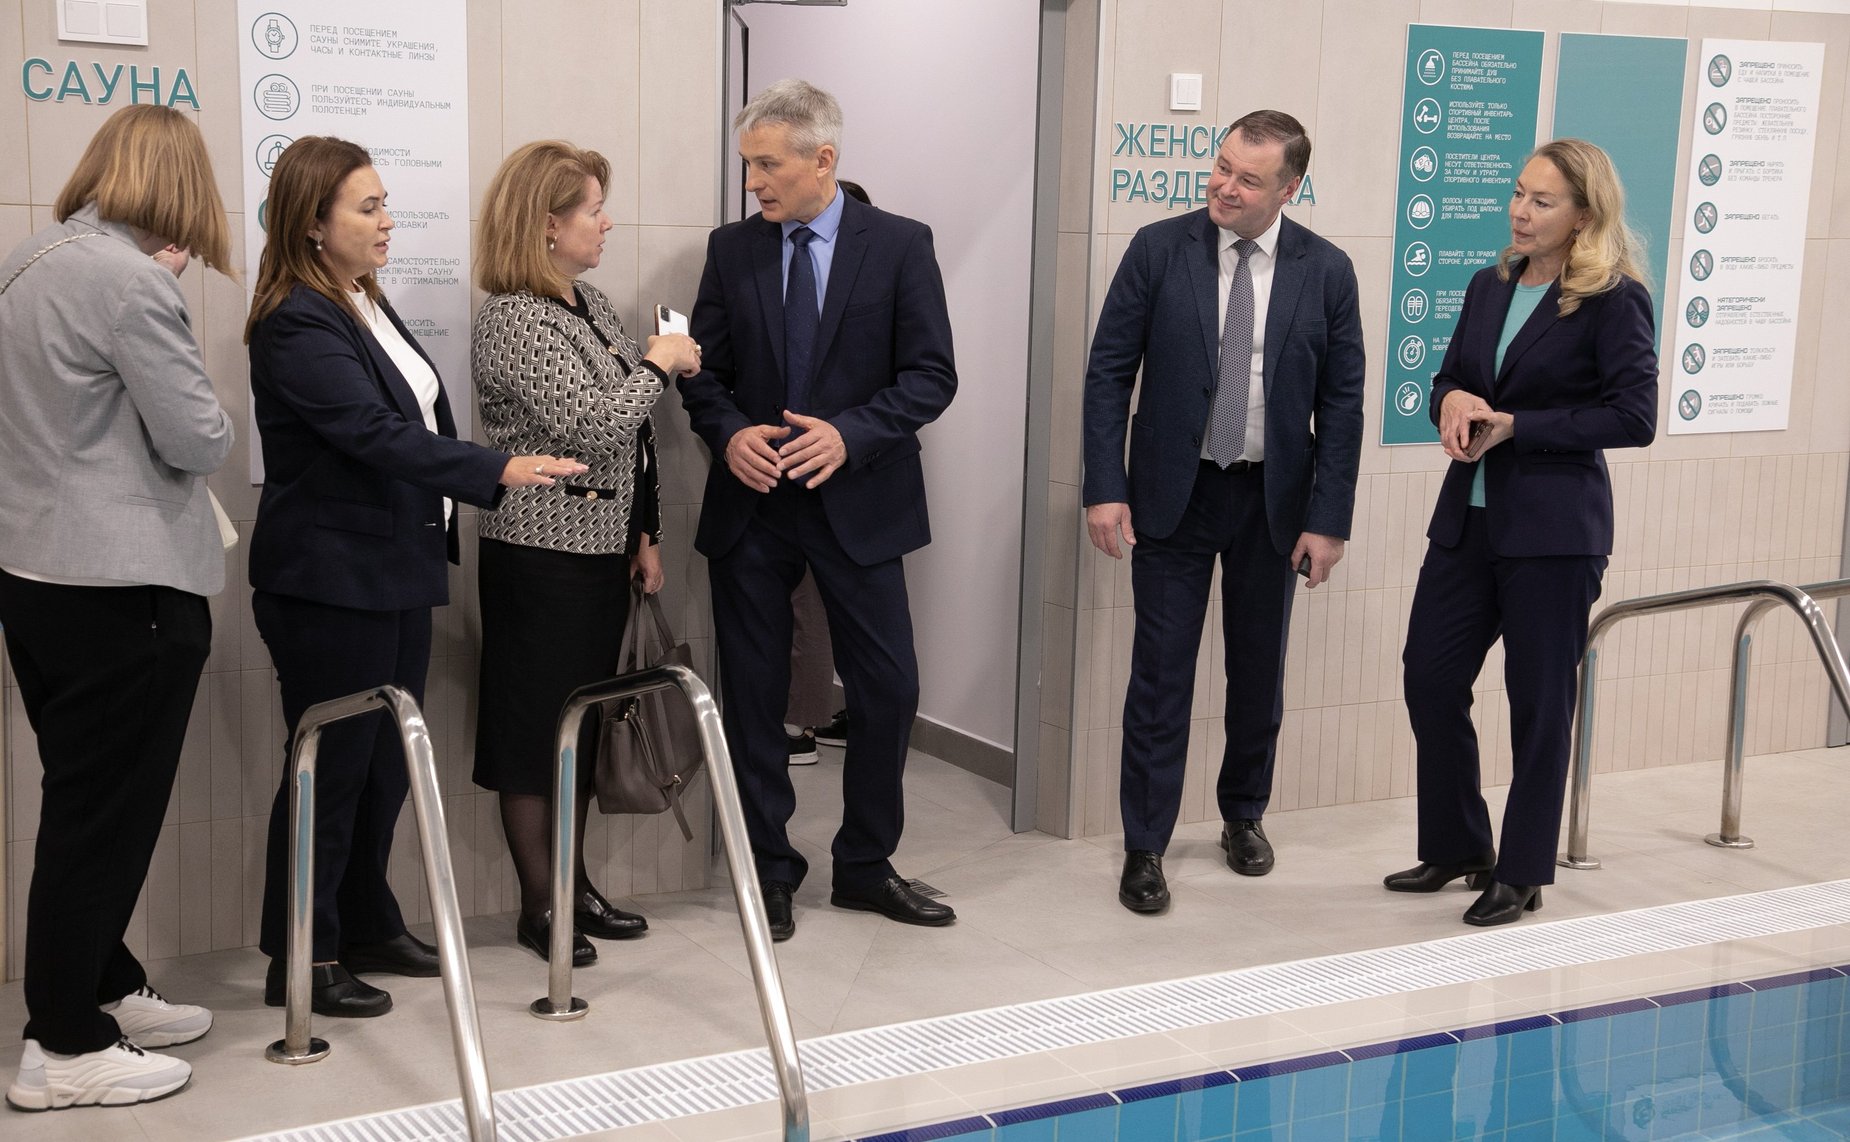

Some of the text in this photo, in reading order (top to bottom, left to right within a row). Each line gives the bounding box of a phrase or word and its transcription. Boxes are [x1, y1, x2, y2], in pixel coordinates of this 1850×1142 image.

[310, 25, 397, 39] ПЕРЕД ПОСЕЩЕНИЕМ
[310, 35, 439, 52] САУНЫ СНИМИТЕ УКРАШЕНИЯ,
[310, 46, 435, 61] ЧАСЫ И КОНТАКТНЫЕ ЛИНЗЫ
[21, 57, 201, 111] САУНА
[312, 85, 415, 97] ПРИ ПОСЕЩЕНИИ САУНЫ
[312, 94, 451, 110] ПОЛЬЗУЙТЕСЬ ИНДИВИДУАЛЬНЫМ
[312, 105, 367, 116] ПОЛОТЕНЦЕМ
[1447, 132, 1482, 140] ВОЗВРАЩАЙТЕ
[395, 158, 442, 168] ГОЛОВНЫМИ
[388, 258, 460, 266] САМОСТОЯТЕЛЬНО
[392, 277, 397, 285] В
[402, 277, 459, 285] ОПТИМАЛЬНОМ
